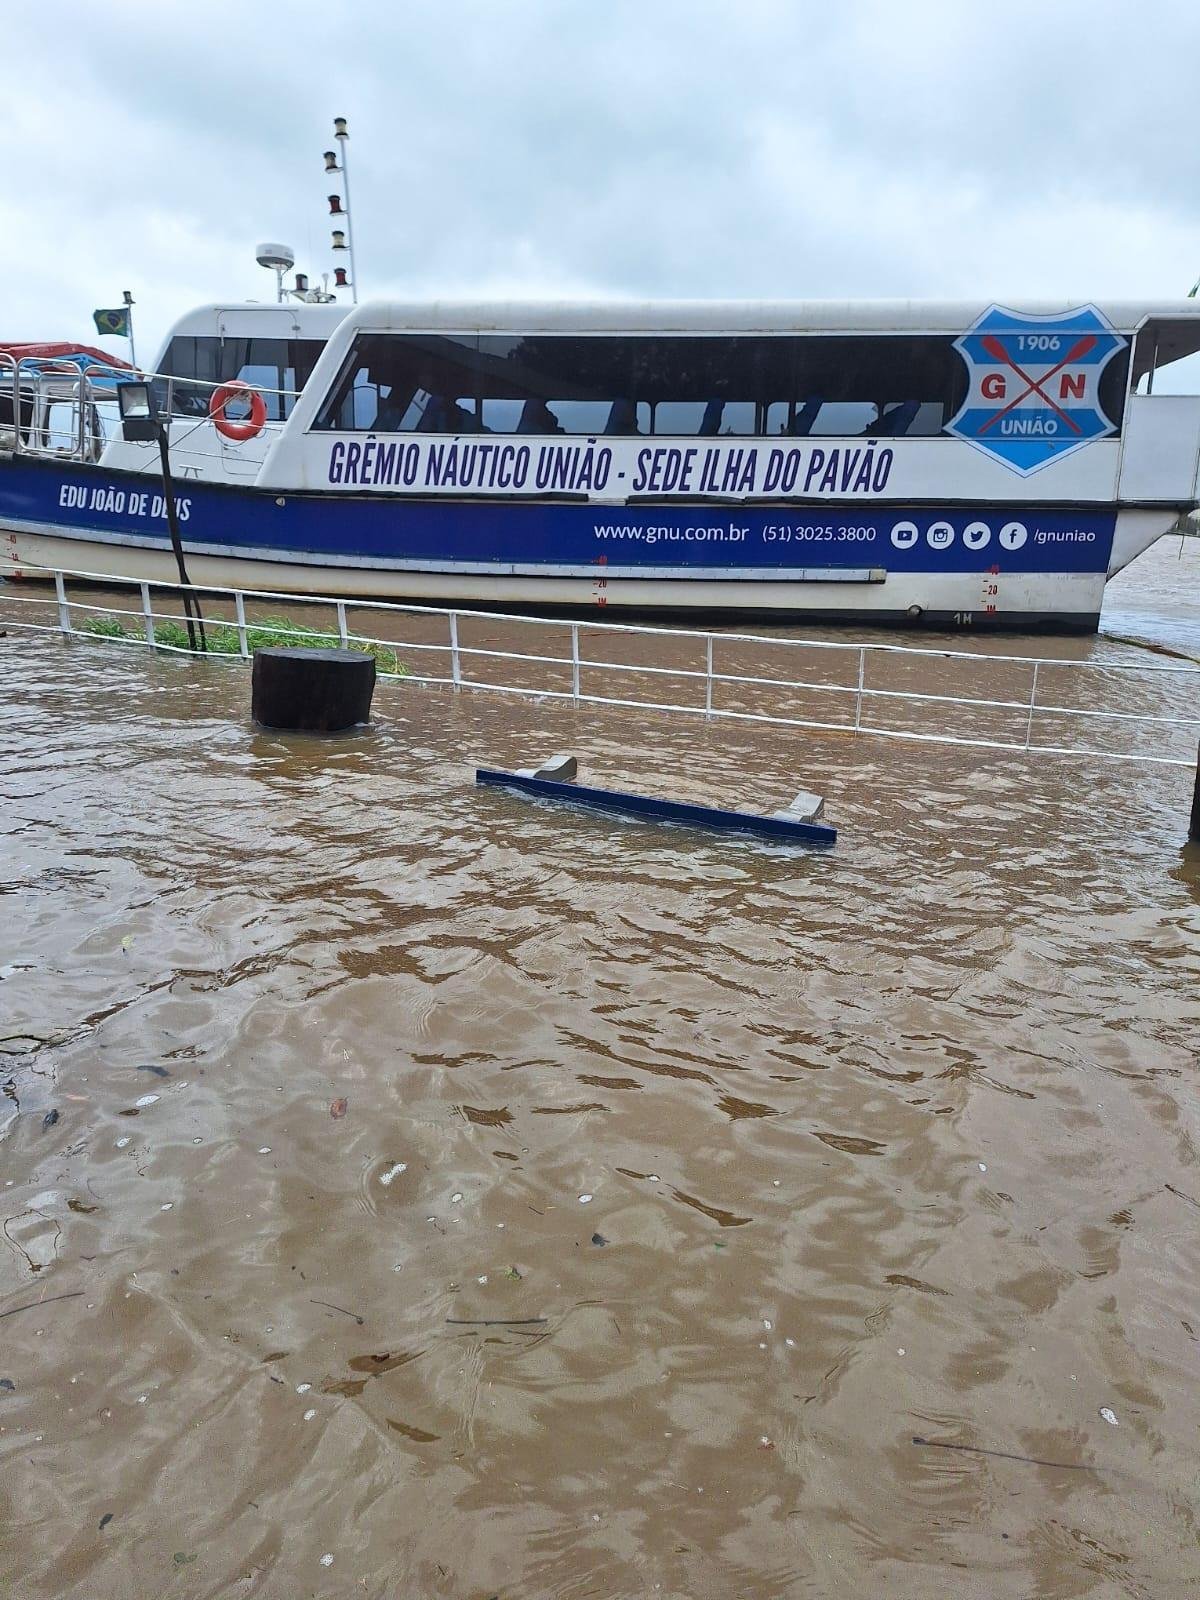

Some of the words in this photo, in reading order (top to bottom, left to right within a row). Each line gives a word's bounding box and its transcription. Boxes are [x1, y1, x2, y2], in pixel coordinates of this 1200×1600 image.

[1017, 335, 1061, 351] 1906
[981, 373, 1006, 399] G
[1059, 374, 1086, 399] N
[1001, 416, 1058, 435] UNIÃO
[328, 434, 420, 486] GRÊMIO
[424, 436, 530, 488] NÁUTICO
[535, 438, 612, 491] UNIÃO
[632, 448, 698, 492] SEDE
[700, 448, 757, 492] ILHA
[762, 448, 801, 492] DO
[803, 440, 894, 492] PAVÃO
[59, 484, 87, 508] EDU
[89, 486, 125, 513] JOÃO
[128, 493, 149, 516] DE
[594, 524, 750, 543] www.gnu.com.br
[762, 526, 792, 542] (51)
[795, 526, 877, 542] 3025.3800
[1033, 529, 1096, 544] /gnuniao
